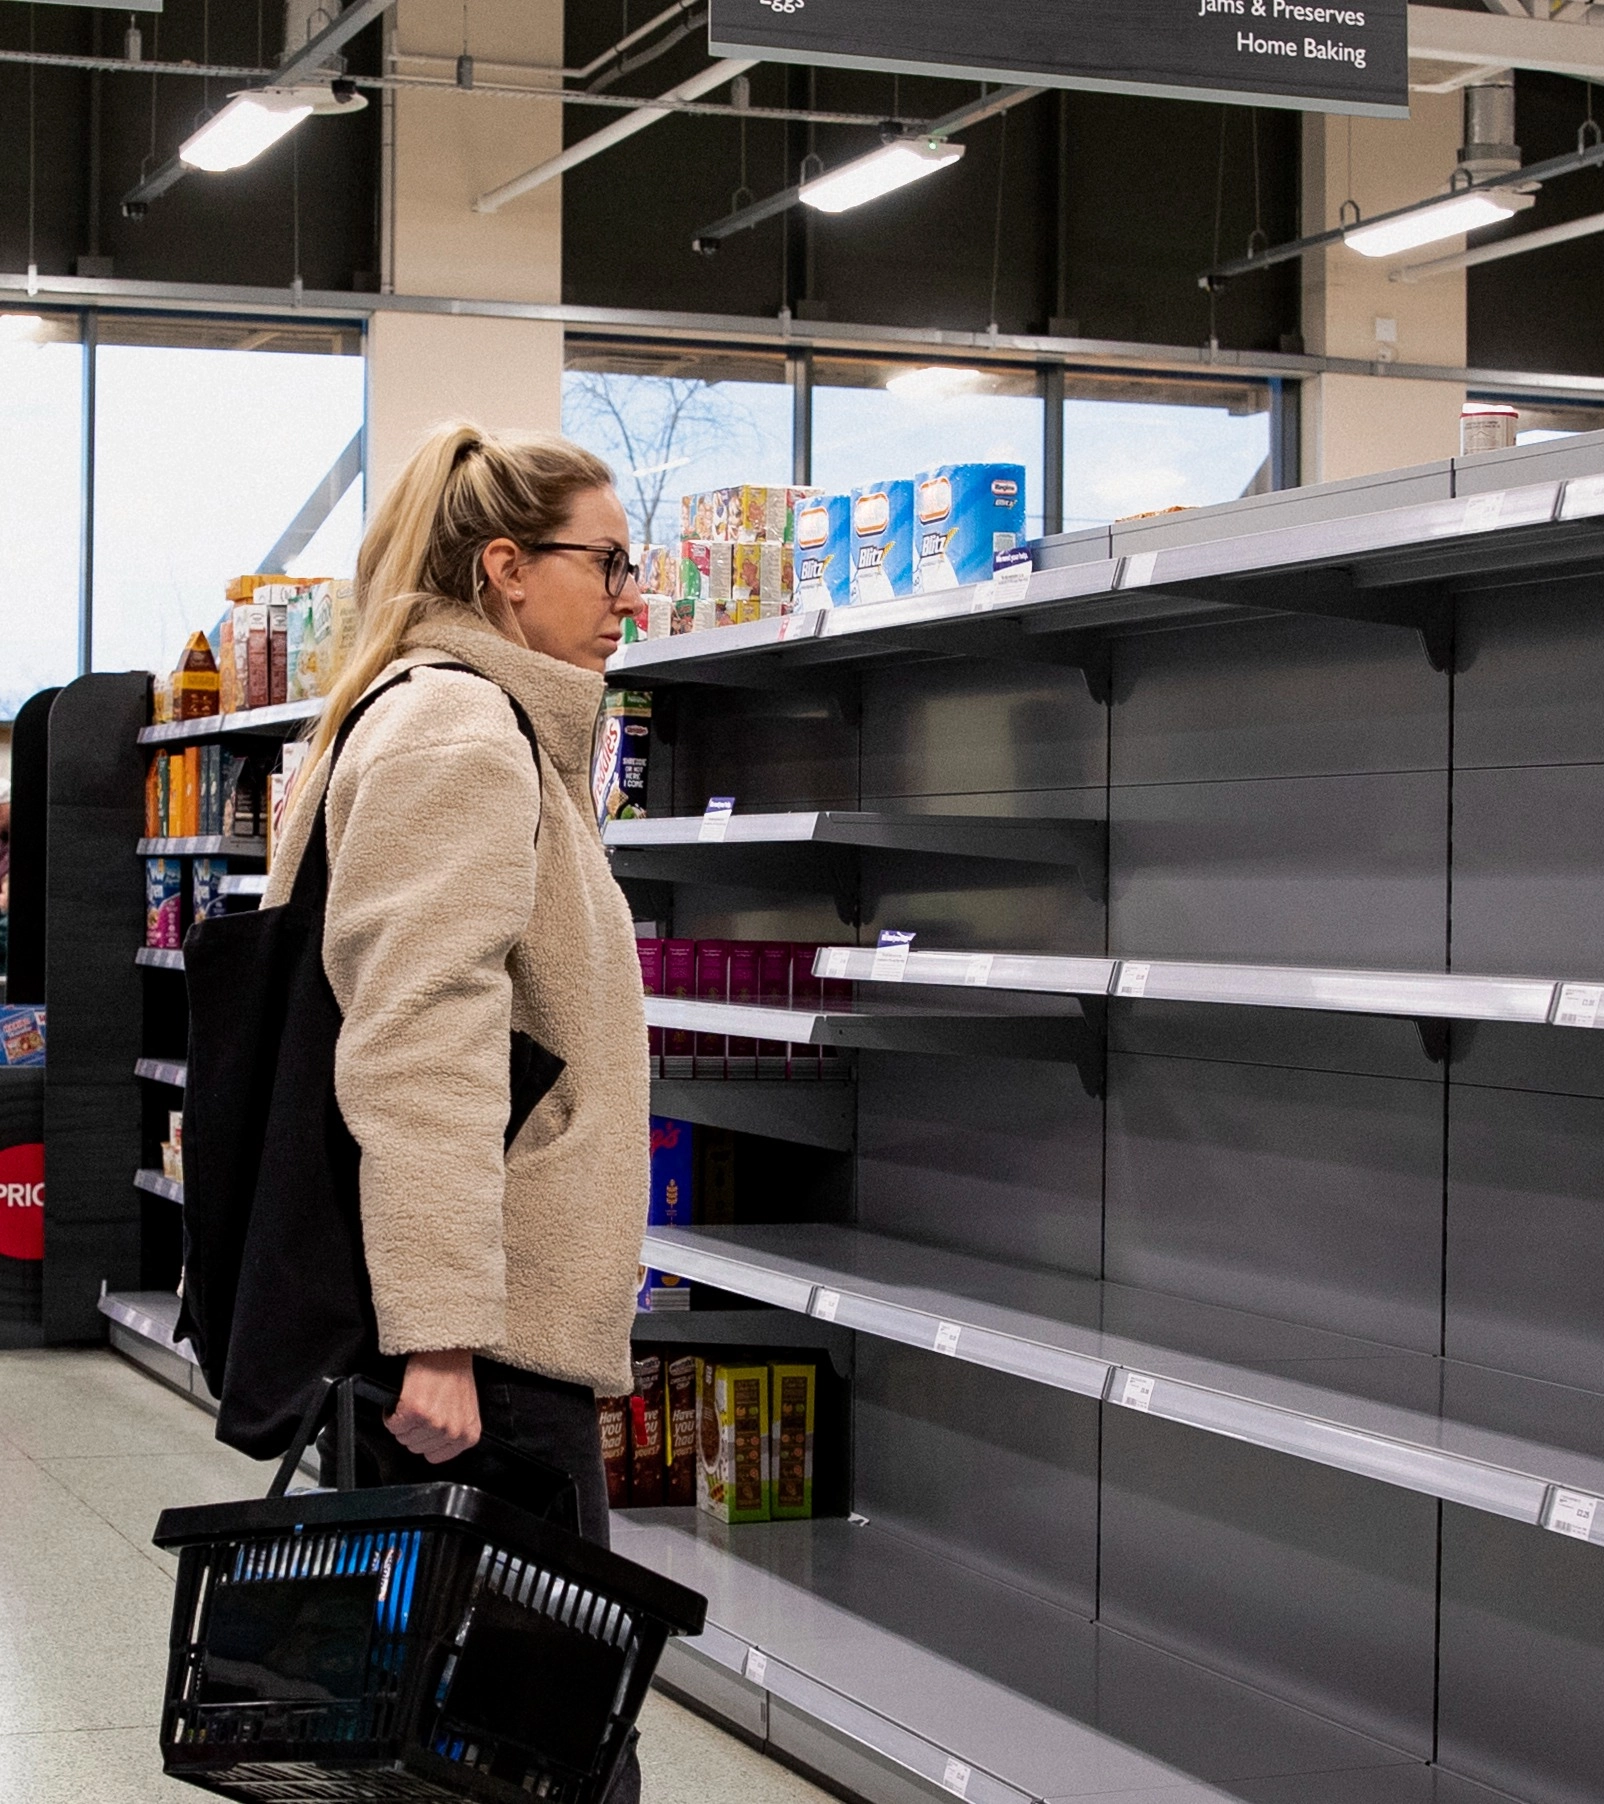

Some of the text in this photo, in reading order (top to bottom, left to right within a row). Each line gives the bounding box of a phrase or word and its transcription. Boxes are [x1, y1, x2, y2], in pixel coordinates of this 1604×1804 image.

[760, 0, 804, 13] ggs
[1198, 0, 1365, 26] Jams & Preserves
[1237, 31, 1366, 68] Home Baking
[922, 534, 946, 557] Blitz
[858, 548, 882, 567] Blitz
[801, 561, 824, 579] Blitz
[600, 1411, 623, 1424] Have
[672, 1410, 695, 1421] Have
[601, 1423, 622, 1439] you
[675, 1421, 694, 1437] you
[602, 1435, 622, 1450] had
[674, 1434, 694, 1447] had
